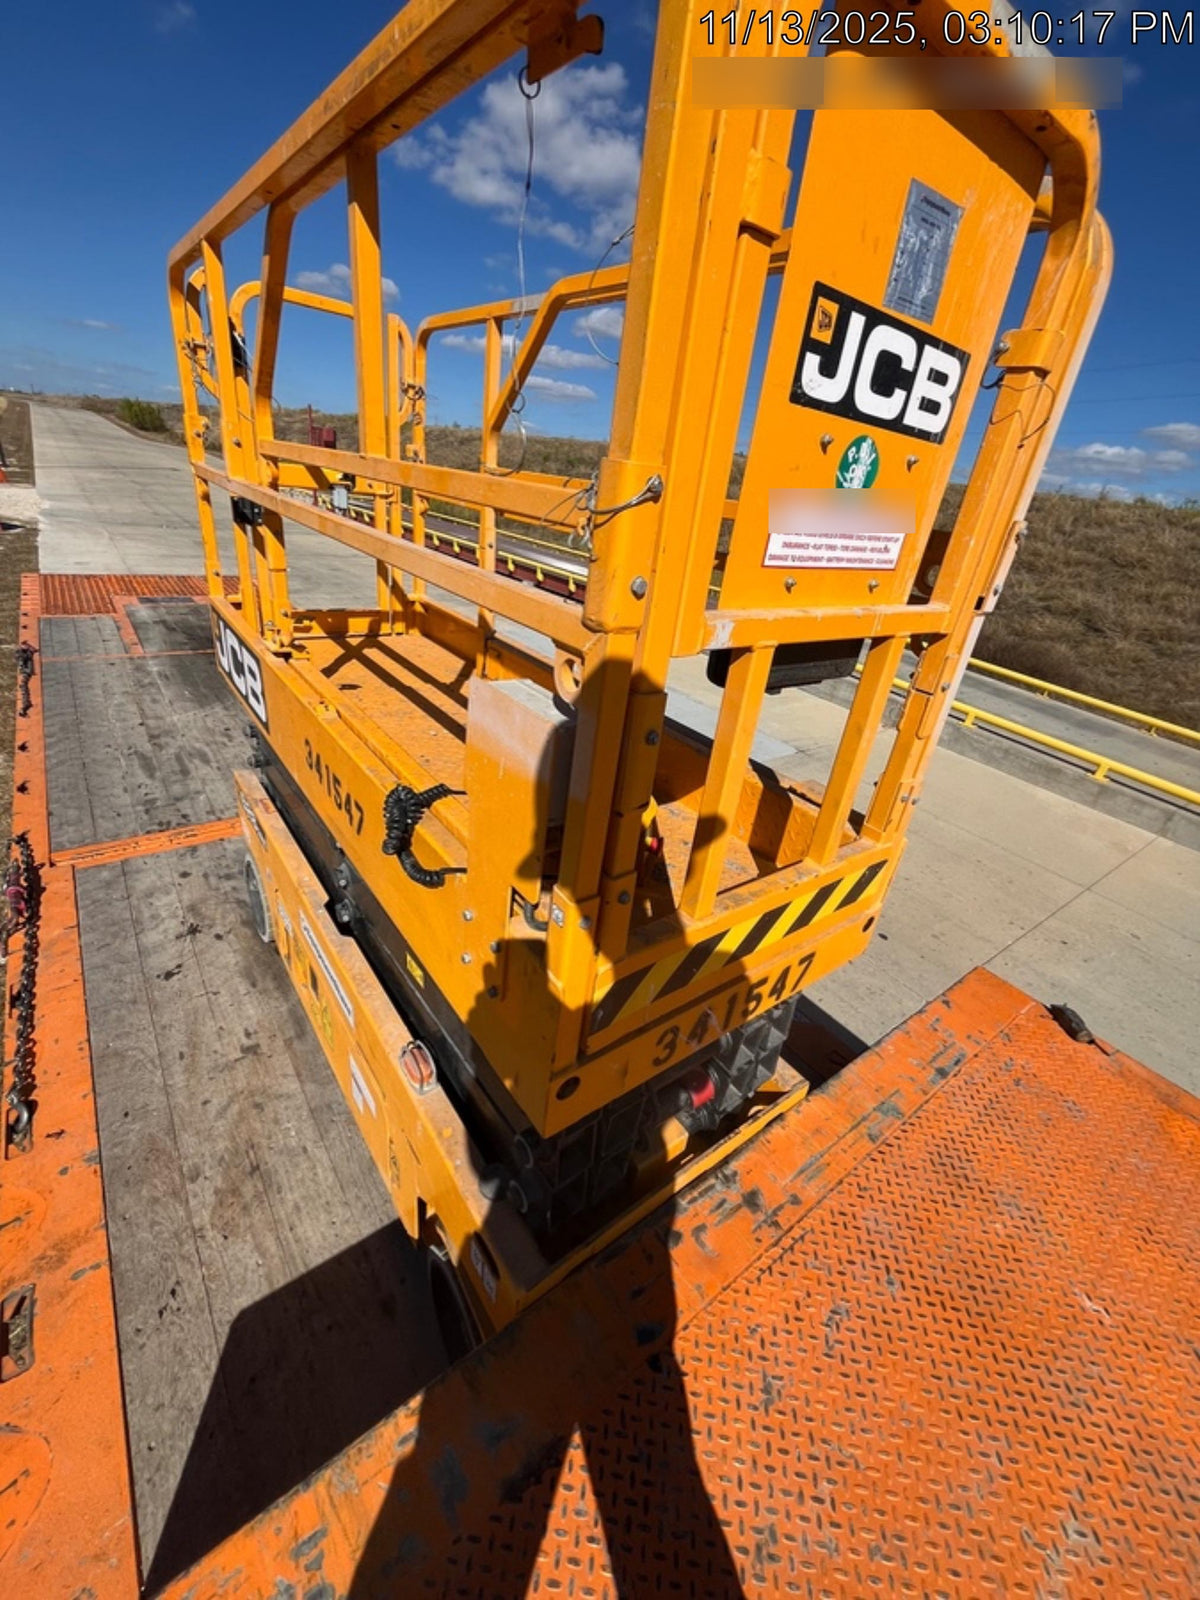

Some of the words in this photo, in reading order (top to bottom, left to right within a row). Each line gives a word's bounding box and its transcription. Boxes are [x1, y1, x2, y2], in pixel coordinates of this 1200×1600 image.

[801, 311, 962, 433] JCB
[216, 620, 267, 722] JCB
[304, 738, 364, 836] 341547
[651, 951, 817, 1068] 341547
